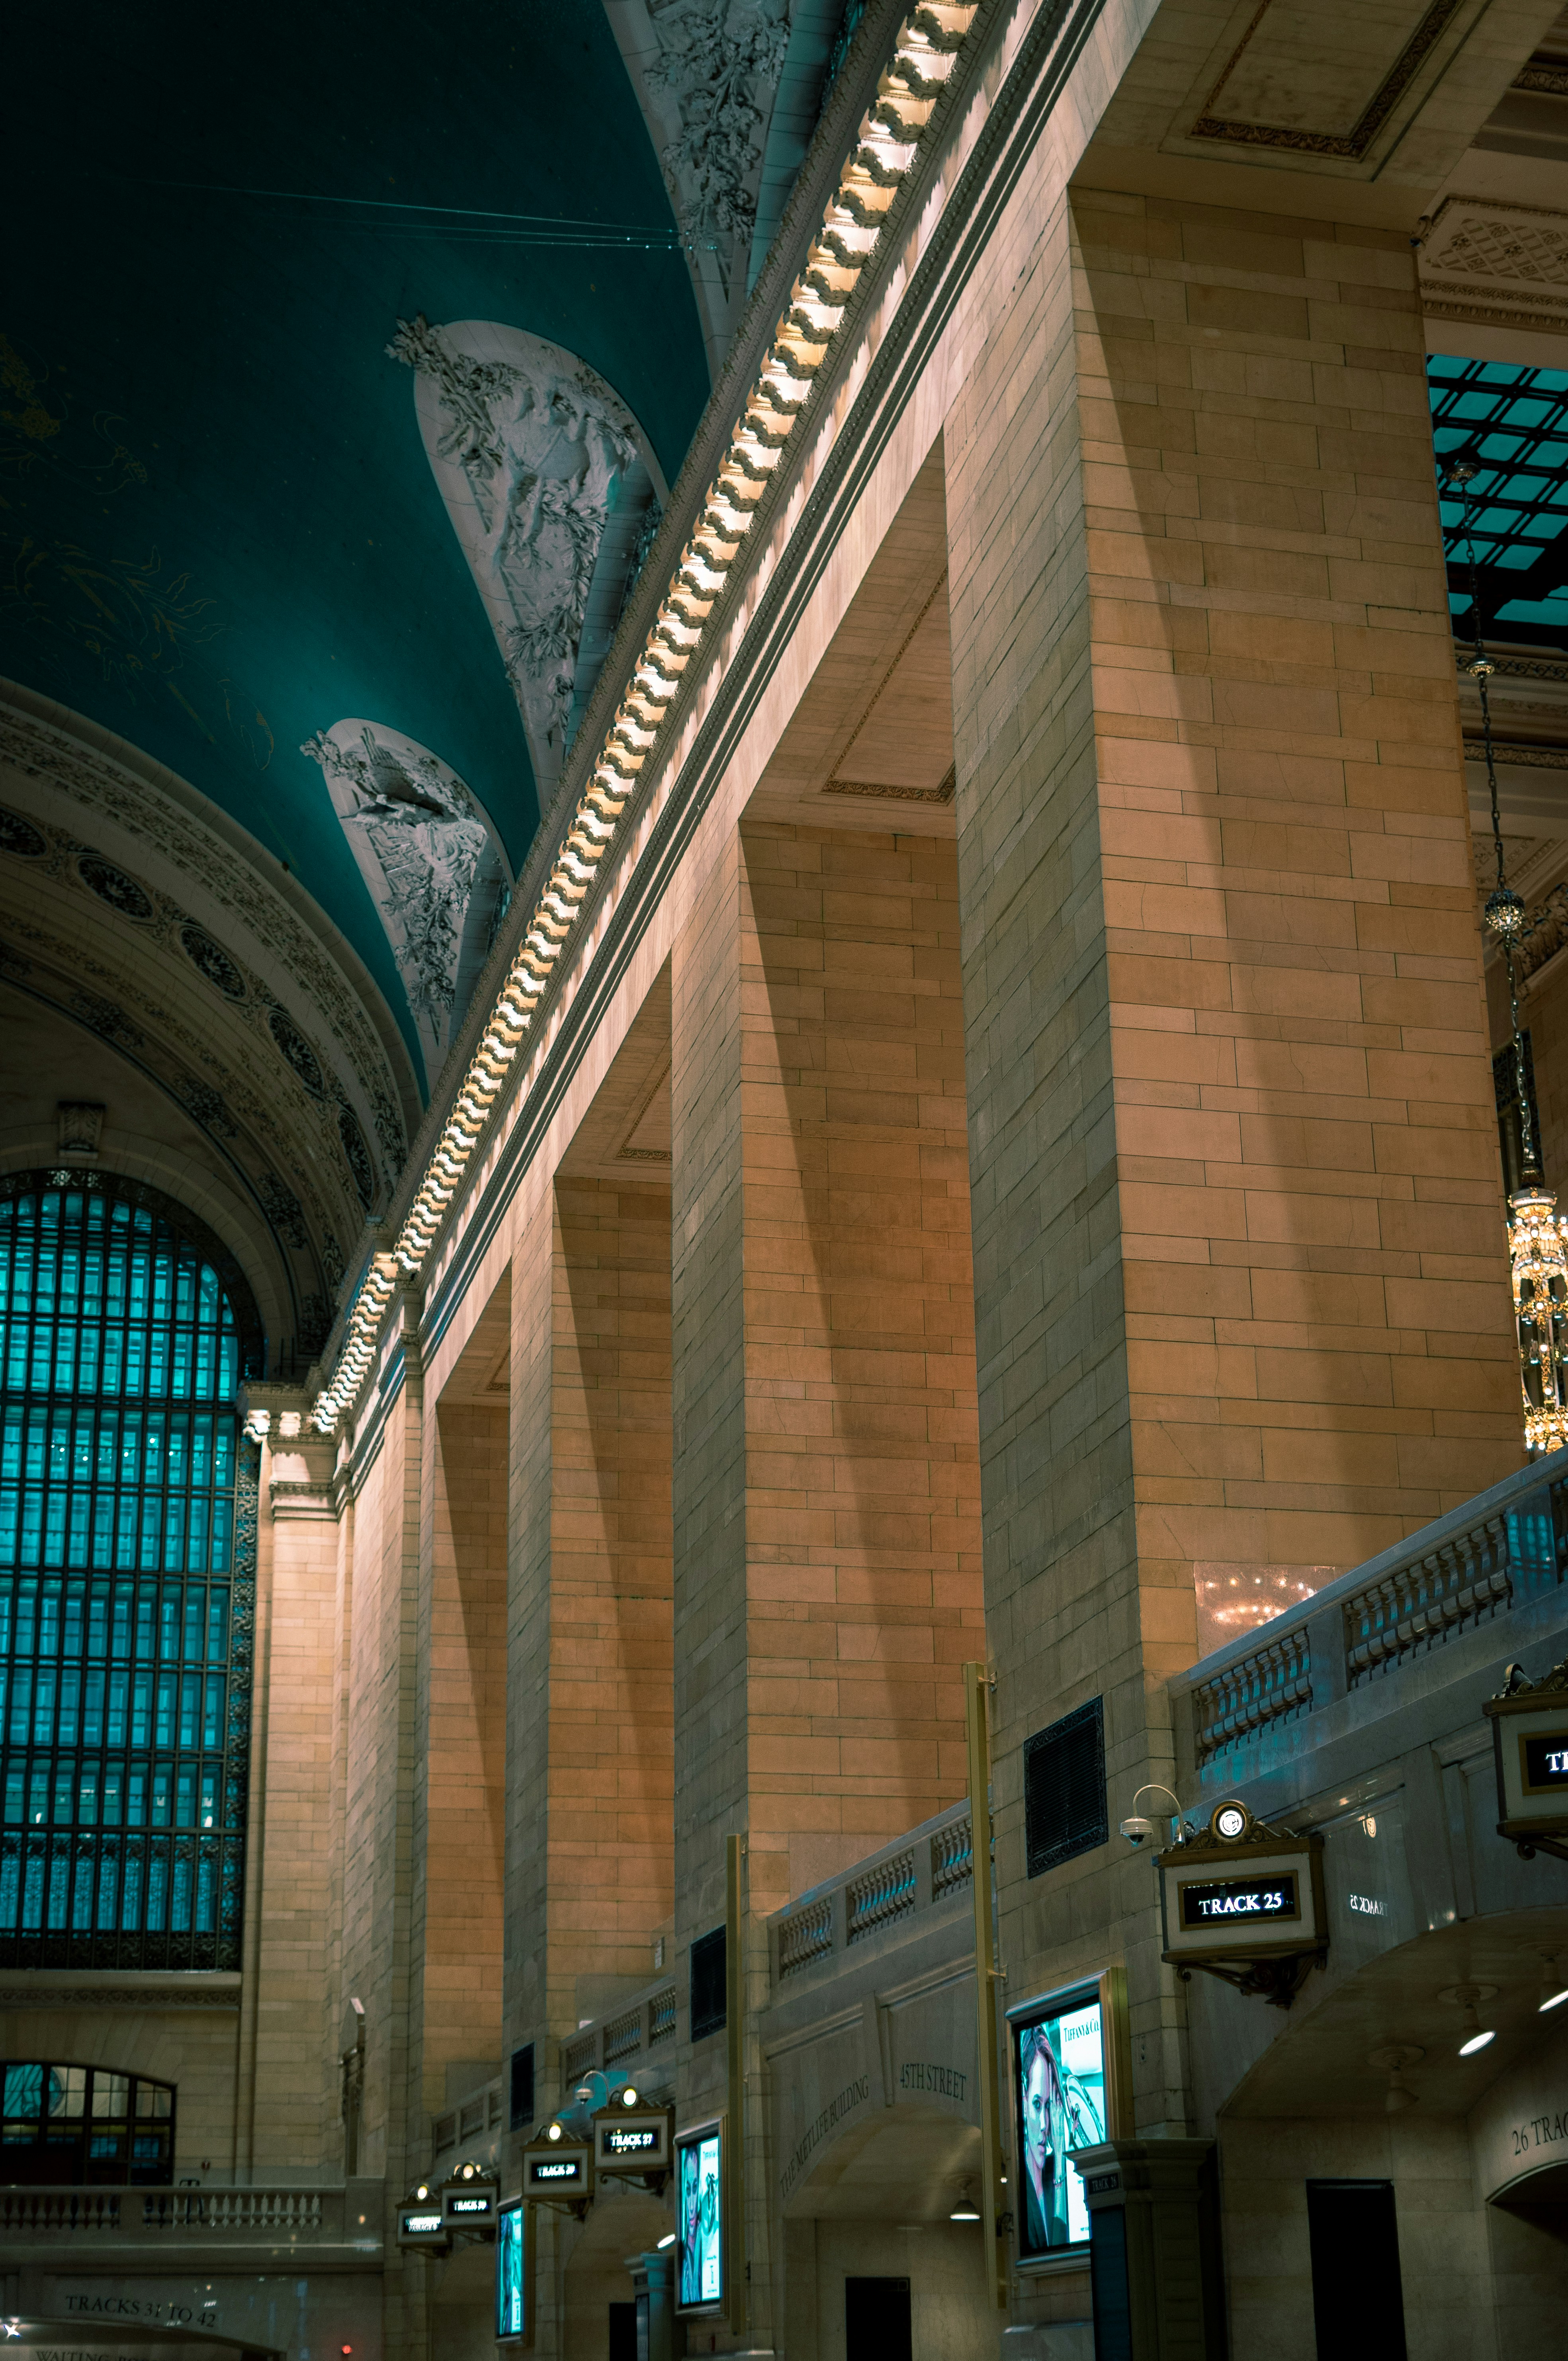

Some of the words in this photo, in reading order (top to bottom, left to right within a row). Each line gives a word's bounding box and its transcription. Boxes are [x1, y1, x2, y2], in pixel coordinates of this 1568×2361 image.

[1198, 1894, 1261, 1915] TRACK
[1263, 1892, 1283, 1909] 25
[900, 2064, 925, 2089] 45TH
[927, 2064, 966, 2101] STREET
[610, 2134, 641, 2146] TRACK
[780, 2158, 796, 2198] THE
[830, 2075, 869, 2128] BUILDING
[1512, 2125, 1529, 2156] 26
[537, 2164, 565, 2177] TRACK
[1092, 2178, 1109, 2192] TRACK
[66, 2296, 140, 2315] TRACKS
[144, 2303, 160, 2318] 31
[168, 2306, 192, 2323] TO
[197, 2312, 216, 2328] 42
